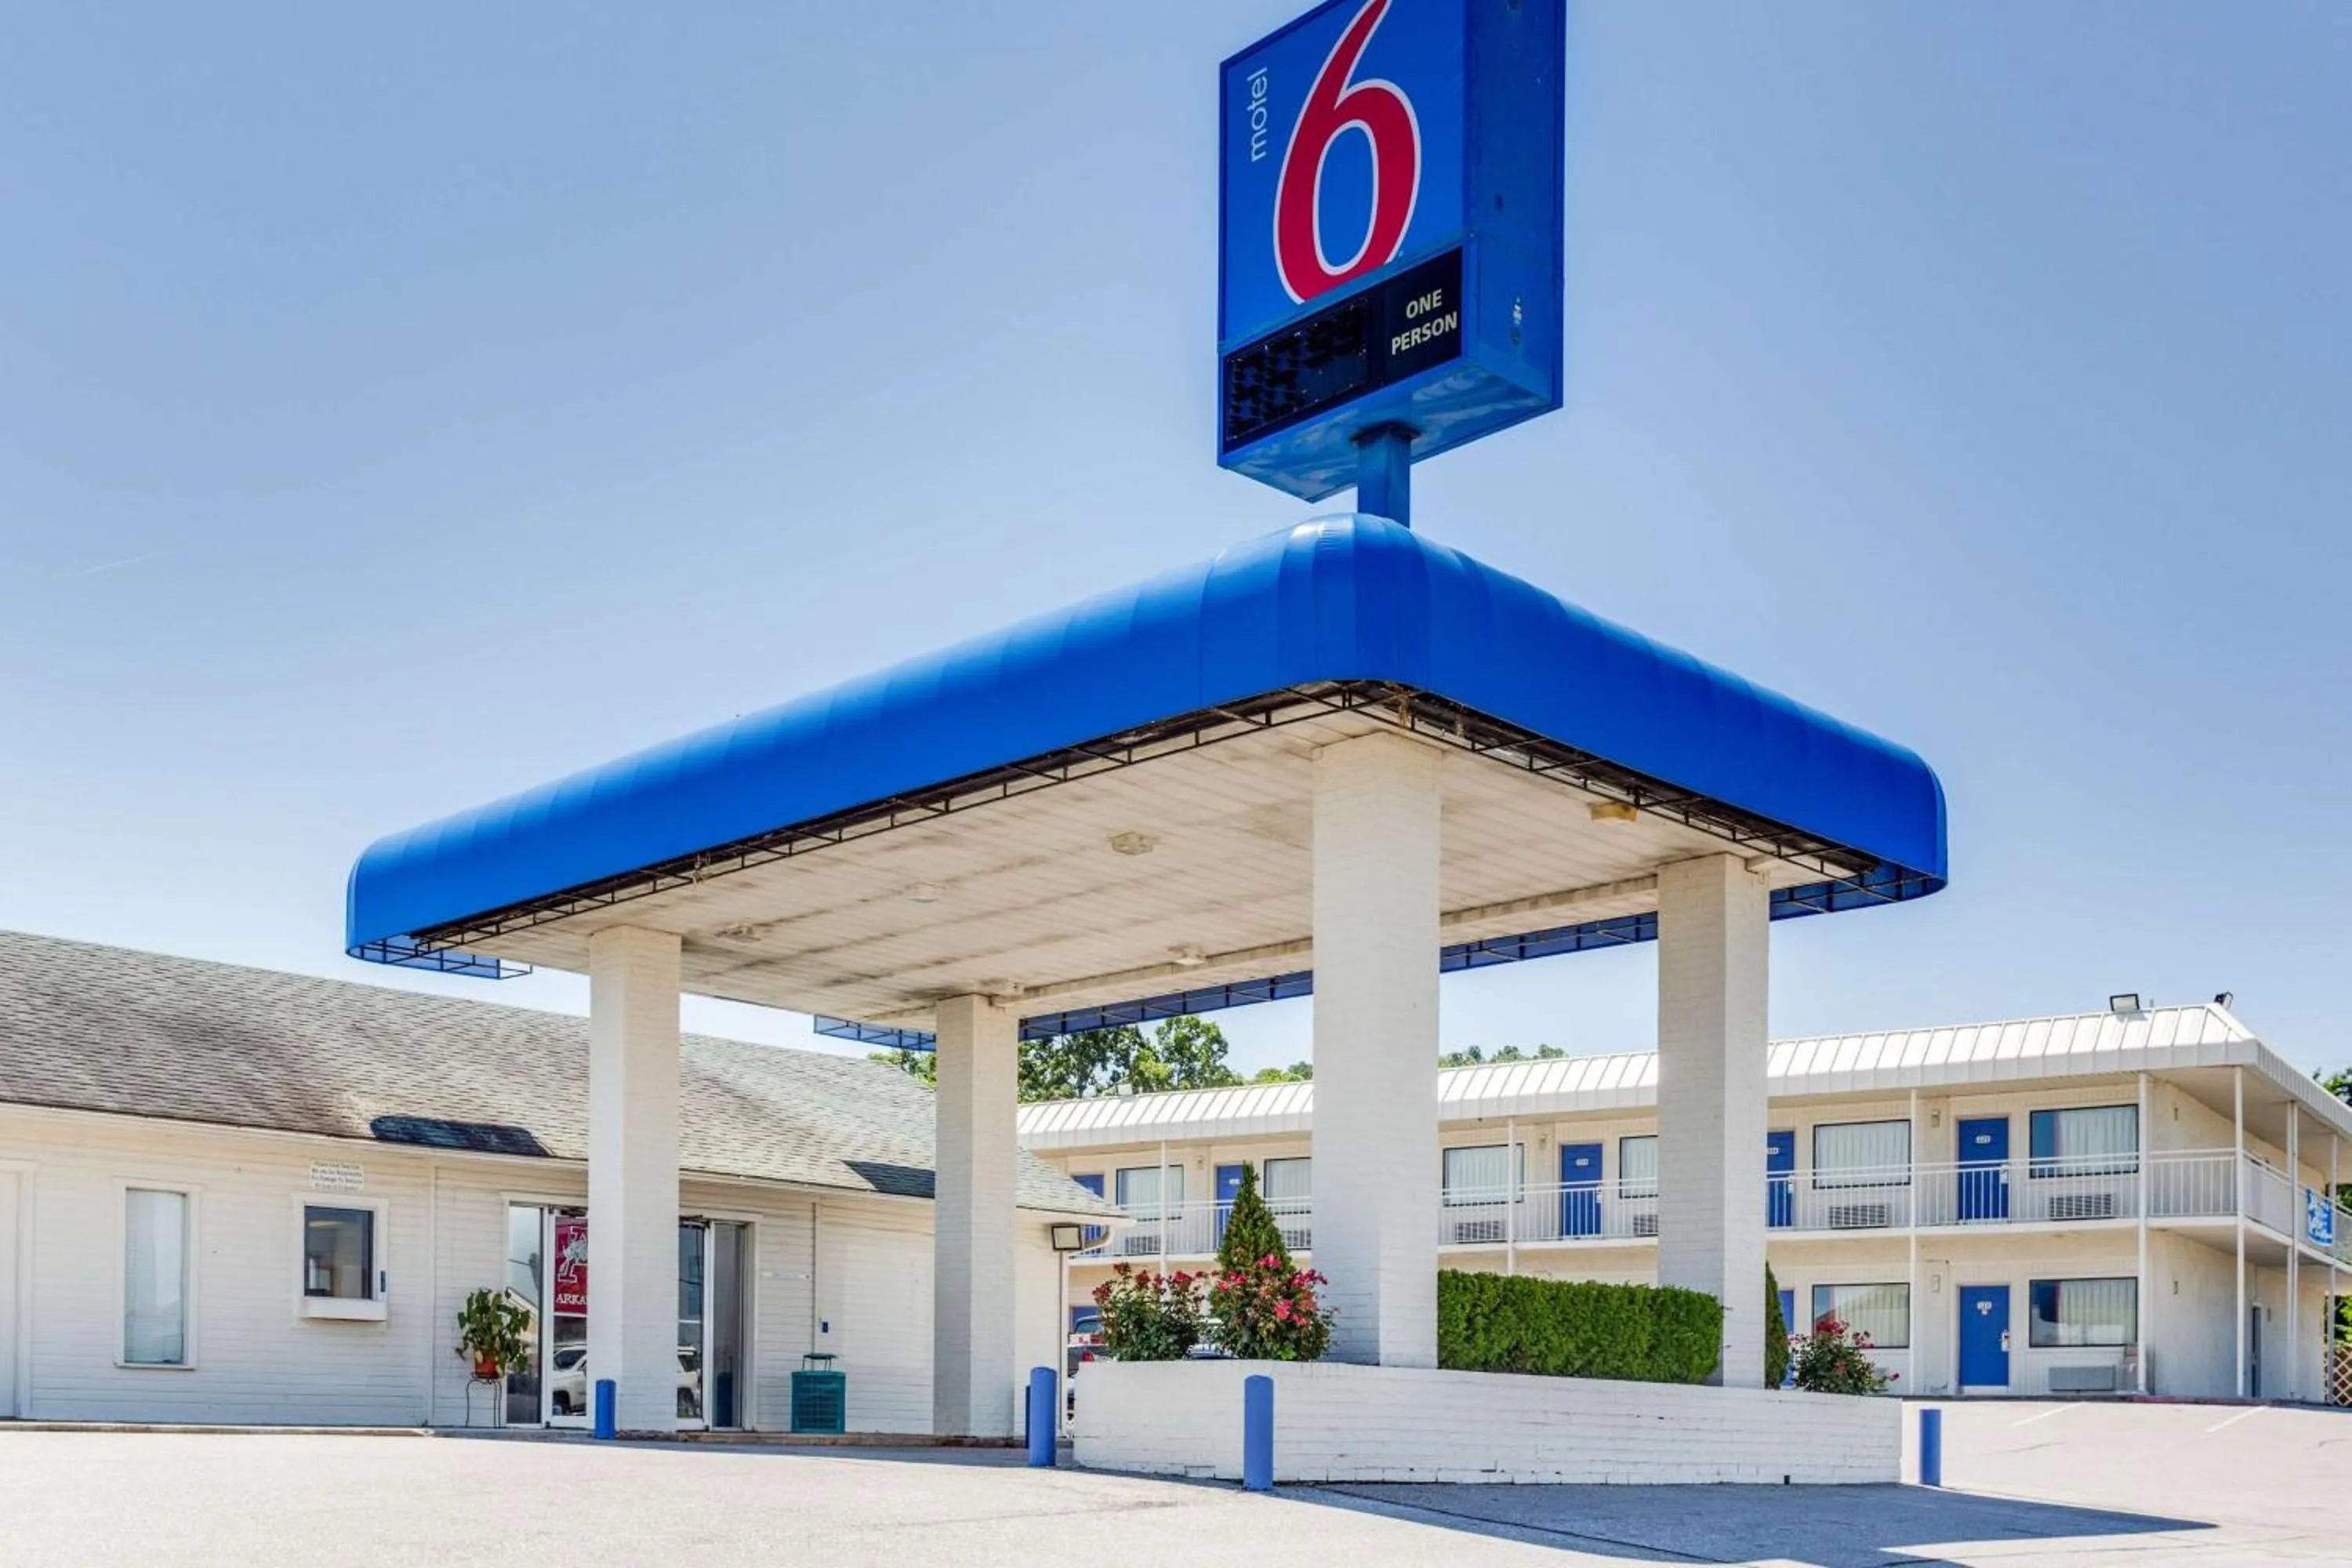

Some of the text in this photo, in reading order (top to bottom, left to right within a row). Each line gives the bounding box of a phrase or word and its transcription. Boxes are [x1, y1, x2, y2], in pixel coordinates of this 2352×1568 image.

[1246, 67, 1268, 162] motel
[1273, 0, 1421, 305] 6
[1406, 289, 1443, 319] ONE
[1392, 310, 1457, 355] PERSON
[556, 1293, 589, 1305] ARKA
